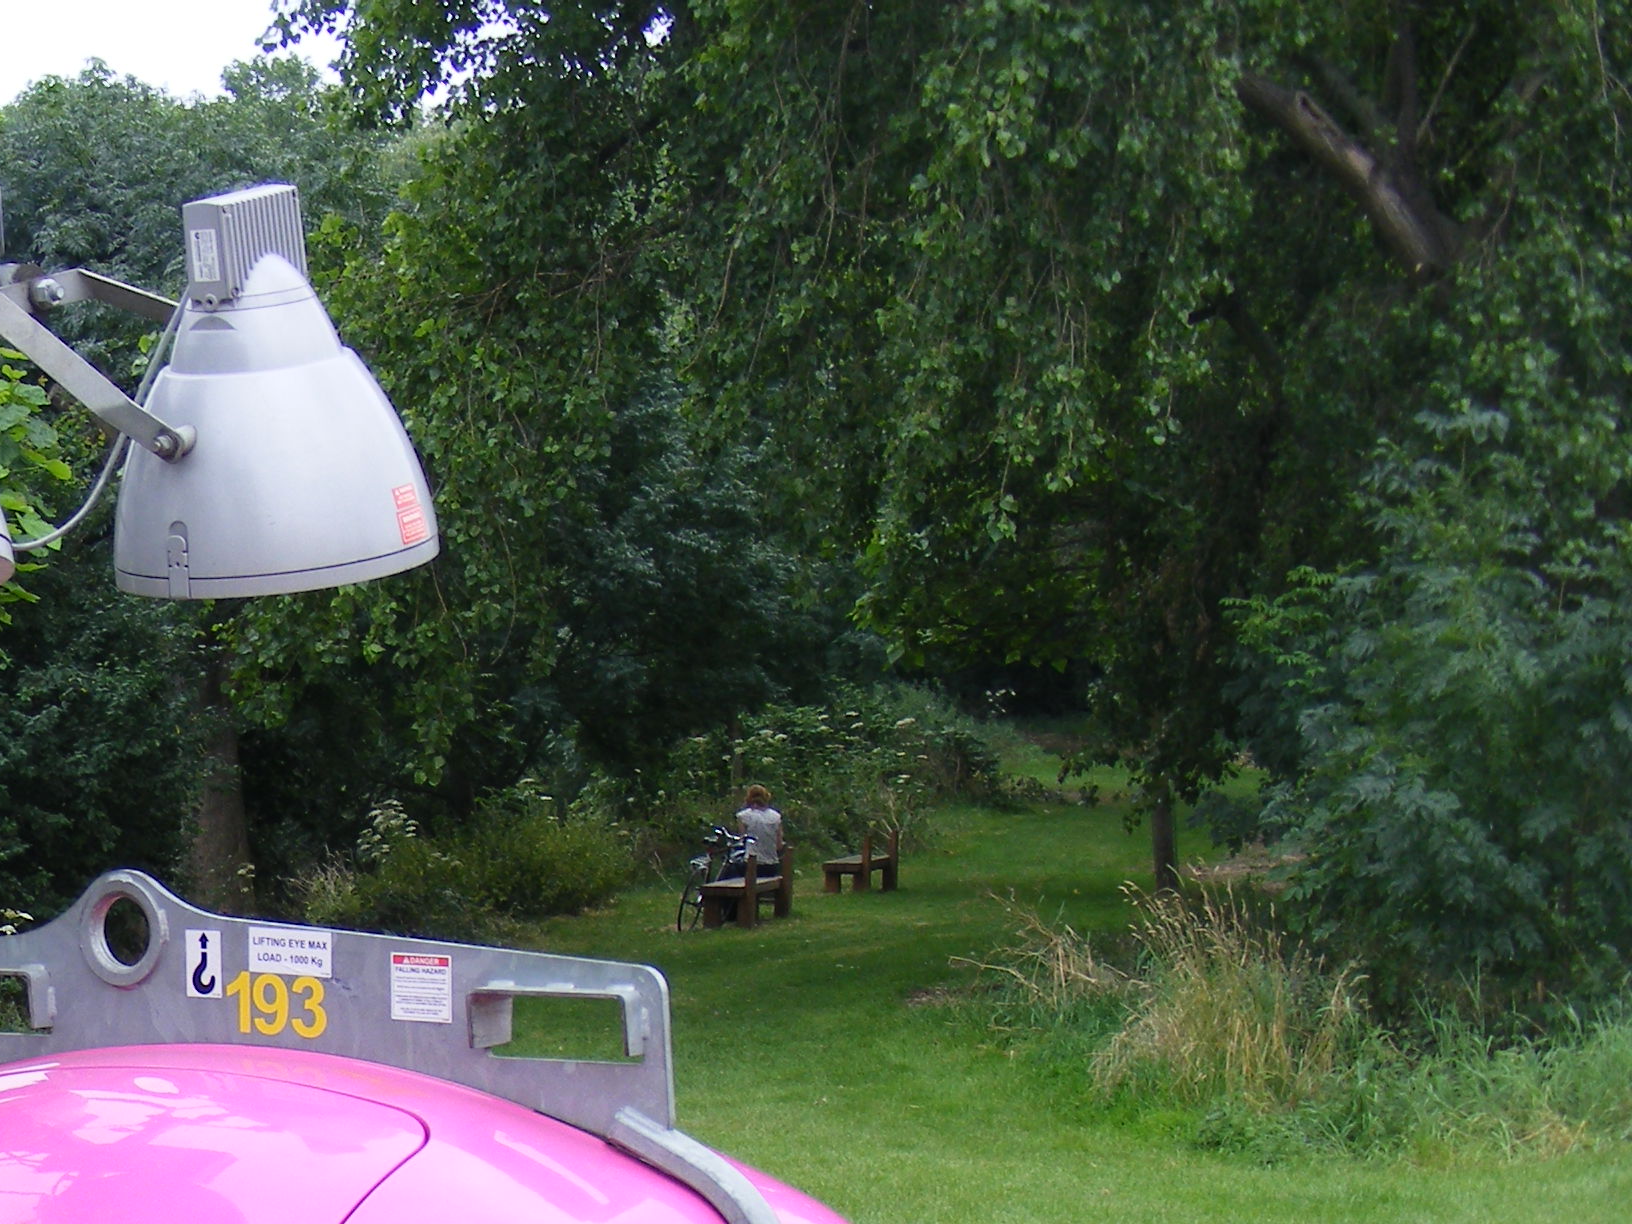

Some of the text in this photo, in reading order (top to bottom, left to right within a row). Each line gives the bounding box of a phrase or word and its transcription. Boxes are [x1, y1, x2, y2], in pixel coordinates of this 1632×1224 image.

[253, 936, 327, 950] LIFTING EYE MAX
[257, 952, 282, 963] LOAD
[290, 955, 309, 965] 1000
[311, 956, 323, 968] Kg
[226, 971, 328, 1038] 193
